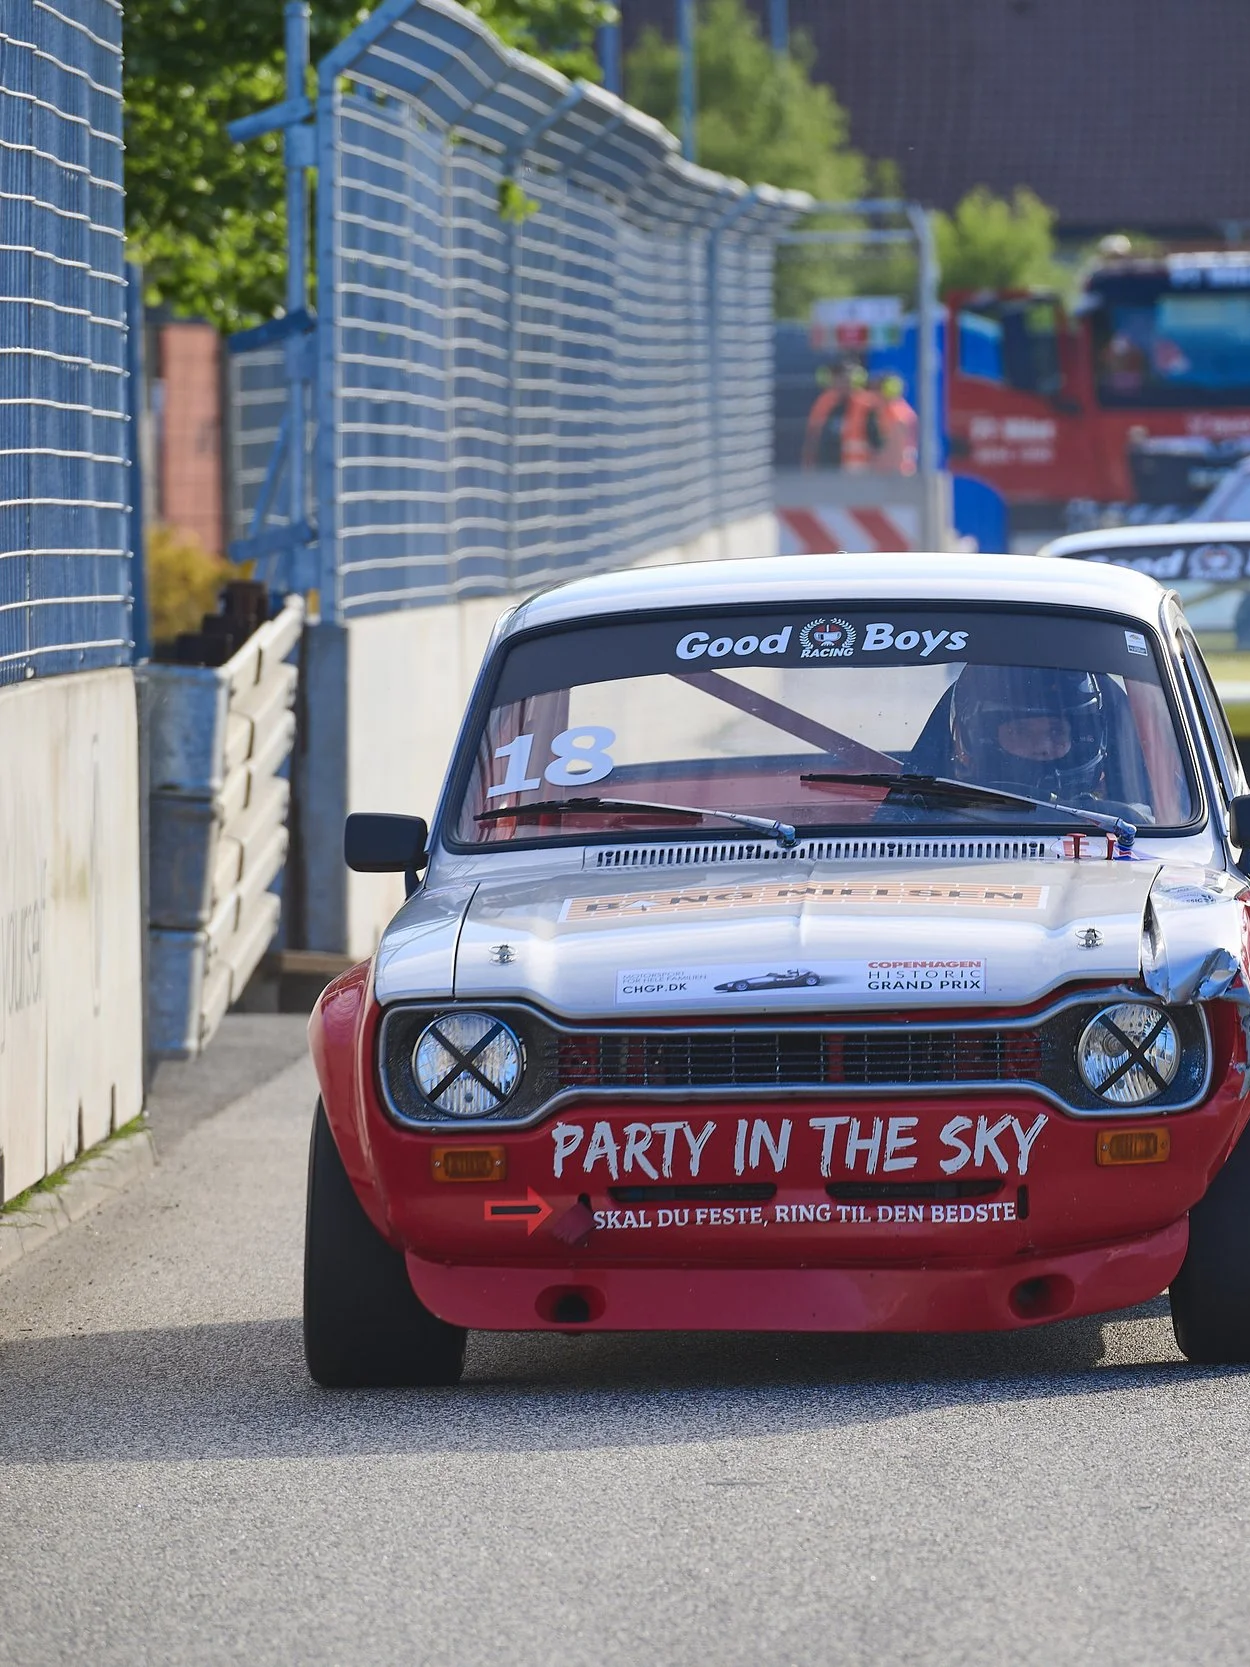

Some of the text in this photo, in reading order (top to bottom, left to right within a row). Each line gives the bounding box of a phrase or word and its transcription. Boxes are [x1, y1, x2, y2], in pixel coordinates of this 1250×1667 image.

[675, 622, 970, 660] Good Boys
[800, 647, 855, 659] RACING
[486, 725, 616, 799] 18
[776, 887, 1024, 900] NIELSEN
[868, 960, 982, 969] COPENHAGEN
[868, 969, 981, 979] HISTORIC
[622, 982, 688, 994] CHGP.DK
[867, 980, 981, 990] GRAND PRIX
[551, 1113, 1049, 1181] PARTY IN THE SKY
[593, 1201, 1017, 1230] SKAL DU FESTE, RING TIL DEN BEDSTE
